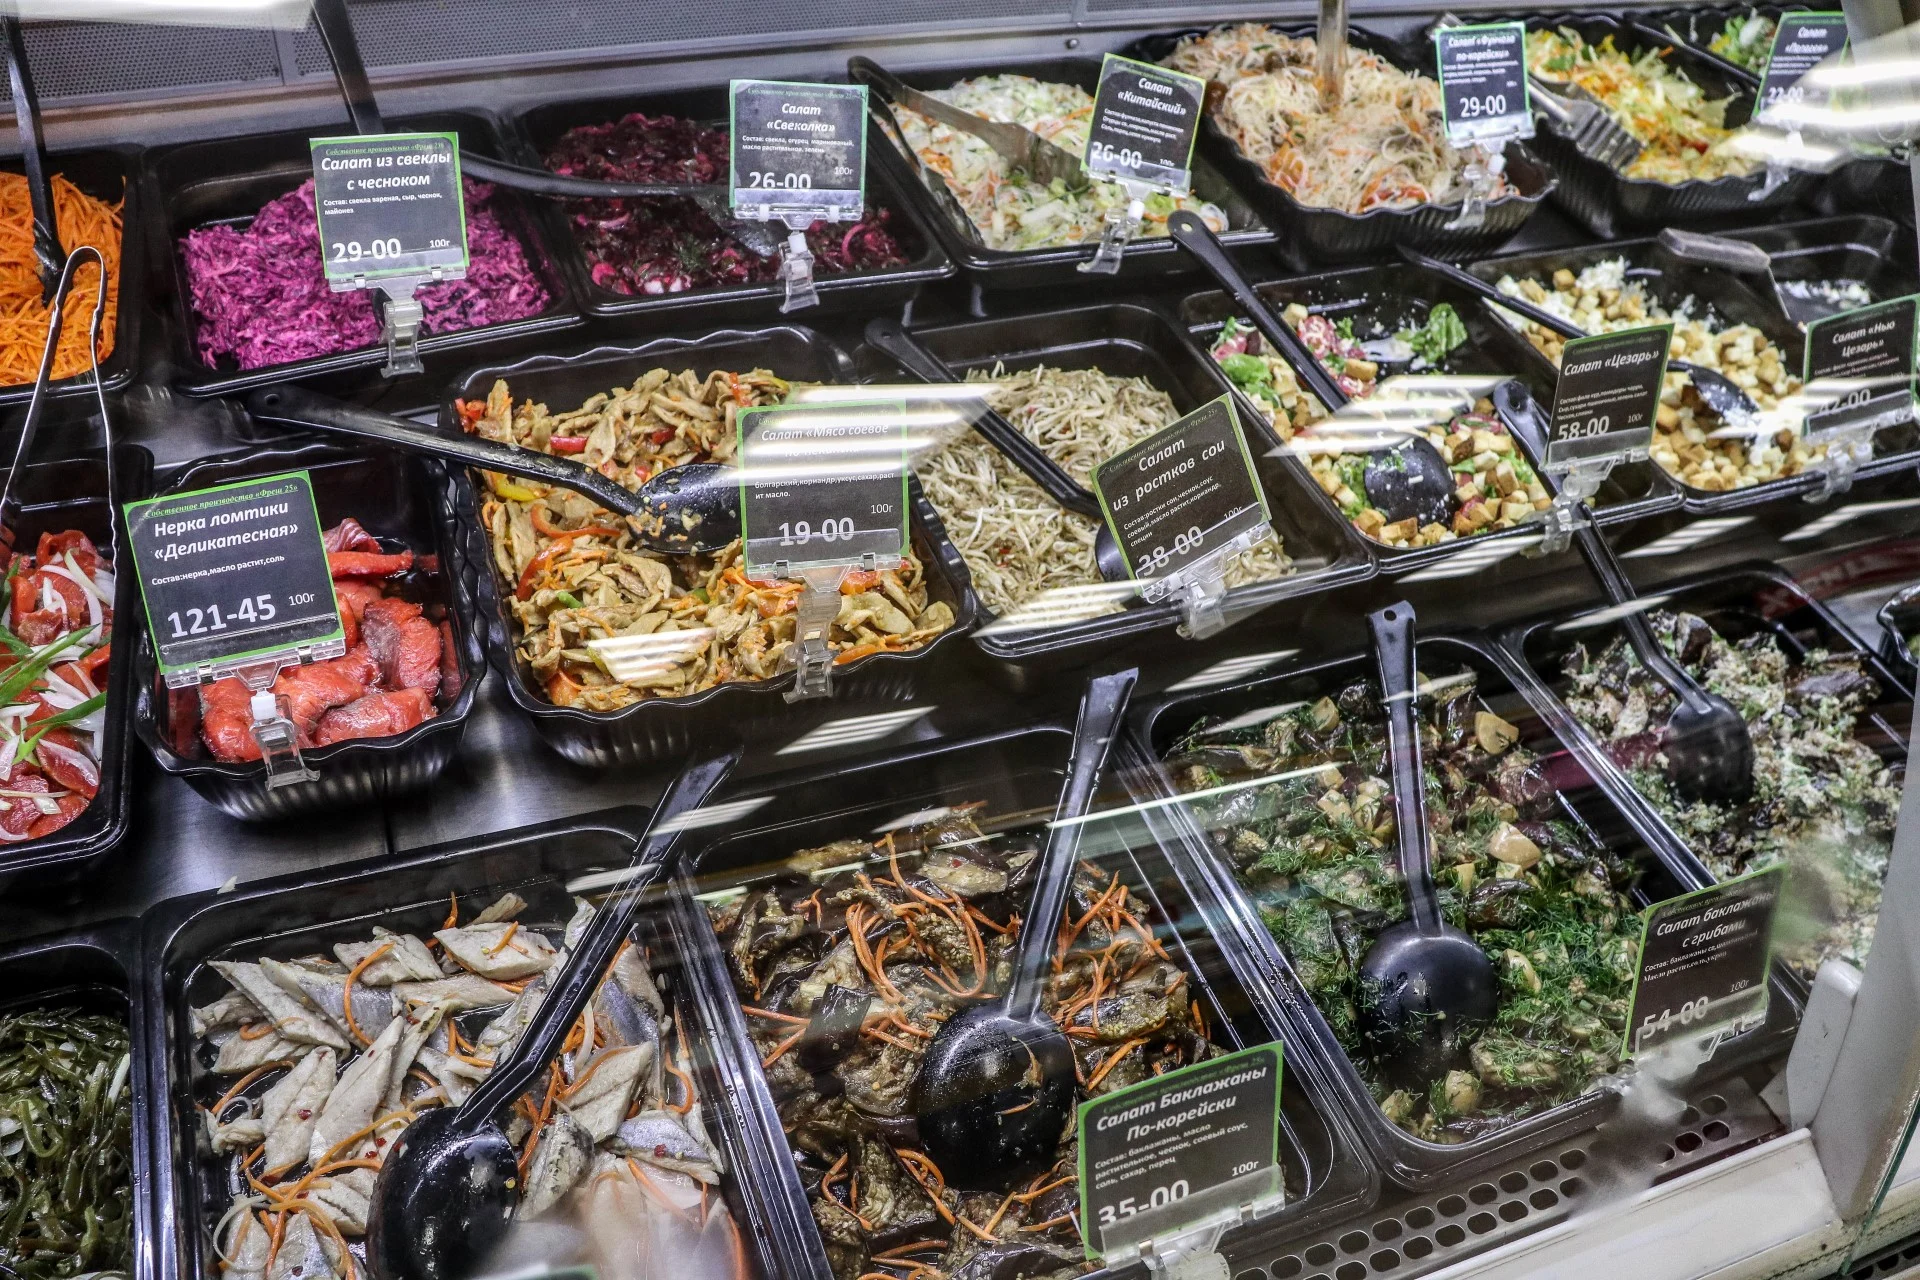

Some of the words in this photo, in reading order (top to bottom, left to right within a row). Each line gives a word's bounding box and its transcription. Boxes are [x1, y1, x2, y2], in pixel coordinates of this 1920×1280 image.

[1138, 78, 1173, 96] Салат
[781, 103, 822, 115] Салат
[1118, 90, 1187, 116] «Китайский»
[1460, 95, 1507, 118] 29-00
[767, 120, 836, 132] «Свеколка»
[321, 157, 372, 171] Салат
[377, 156, 393, 167] из
[396, 153, 450, 166] свеклы
[1092, 141, 1142, 169] 26-00
[347, 180, 354, 190] с
[358, 175, 431, 190] чесноком
[749, 171, 812, 189] 26-00
[332, 238, 402, 263] 29-00
[429, 239, 450, 249] 100г
[1833, 328, 1867, 344] Салат
[1564, 360, 1602, 376] Салат
[1604, 350, 1660, 368] «Цезарь»
[761, 429, 803, 441] Салат
[806, 426, 846, 437] «Мясо
[848, 424, 889, 434] соевое
[1557, 416, 1610, 441] 58-00
[1138, 438, 1186, 472] Салат
[1112, 494, 1129, 512] из
[1135, 458, 1195, 501] ростков
[1201, 439, 1226, 461] сои
[765, 491, 791, 499] масло.
[154, 518, 206, 537] Нерка
[209, 503, 289, 527] ломтики
[871, 504, 893, 514] 100г
[154, 523, 299, 561] «Деликатесная»
[778, 517, 855, 547] 19-00
[1138, 525, 1204, 577] 3800
[151, 563, 236, 586] Состав:нерка,масло
[237, 554, 285, 570] растит,соль
[288, 592, 315, 607] 100г
[167, 594, 277, 639] 121-45
[1657, 915, 1701, 937] Салат
[1682, 937, 1690, 948] с
[1691, 919, 1746, 947] грибами
[1644, 960, 1669, 973] Состав:
[1730, 979, 1750, 993] 100г
[1642, 996, 1709, 1040] 5400
[1096, 1101, 1156, 1131] Салат
[1160, 1067, 1268, 1109] Баклажаны
[1126, 1095, 1237, 1142] По-корейски
[1094, 1152, 1128, 1169] Состав:
[1128, 1133, 1182, 1156] баклажаны,
[1183, 1123, 1212, 1138] масло
[1095, 1153, 1158, 1181] растительное,
[1158, 1141, 1191, 1156] чеснок,
[1192, 1129, 1226, 1145] соевый
[1095, 1178, 1119, 1190] соль,
[1119, 1168, 1147, 1181] сахар,
[1148, 1157, 1176, 1171] перец
[1231, 1161, 1259, 1177] 100г
[1098, 1179, 1190, 1225] 35-00
